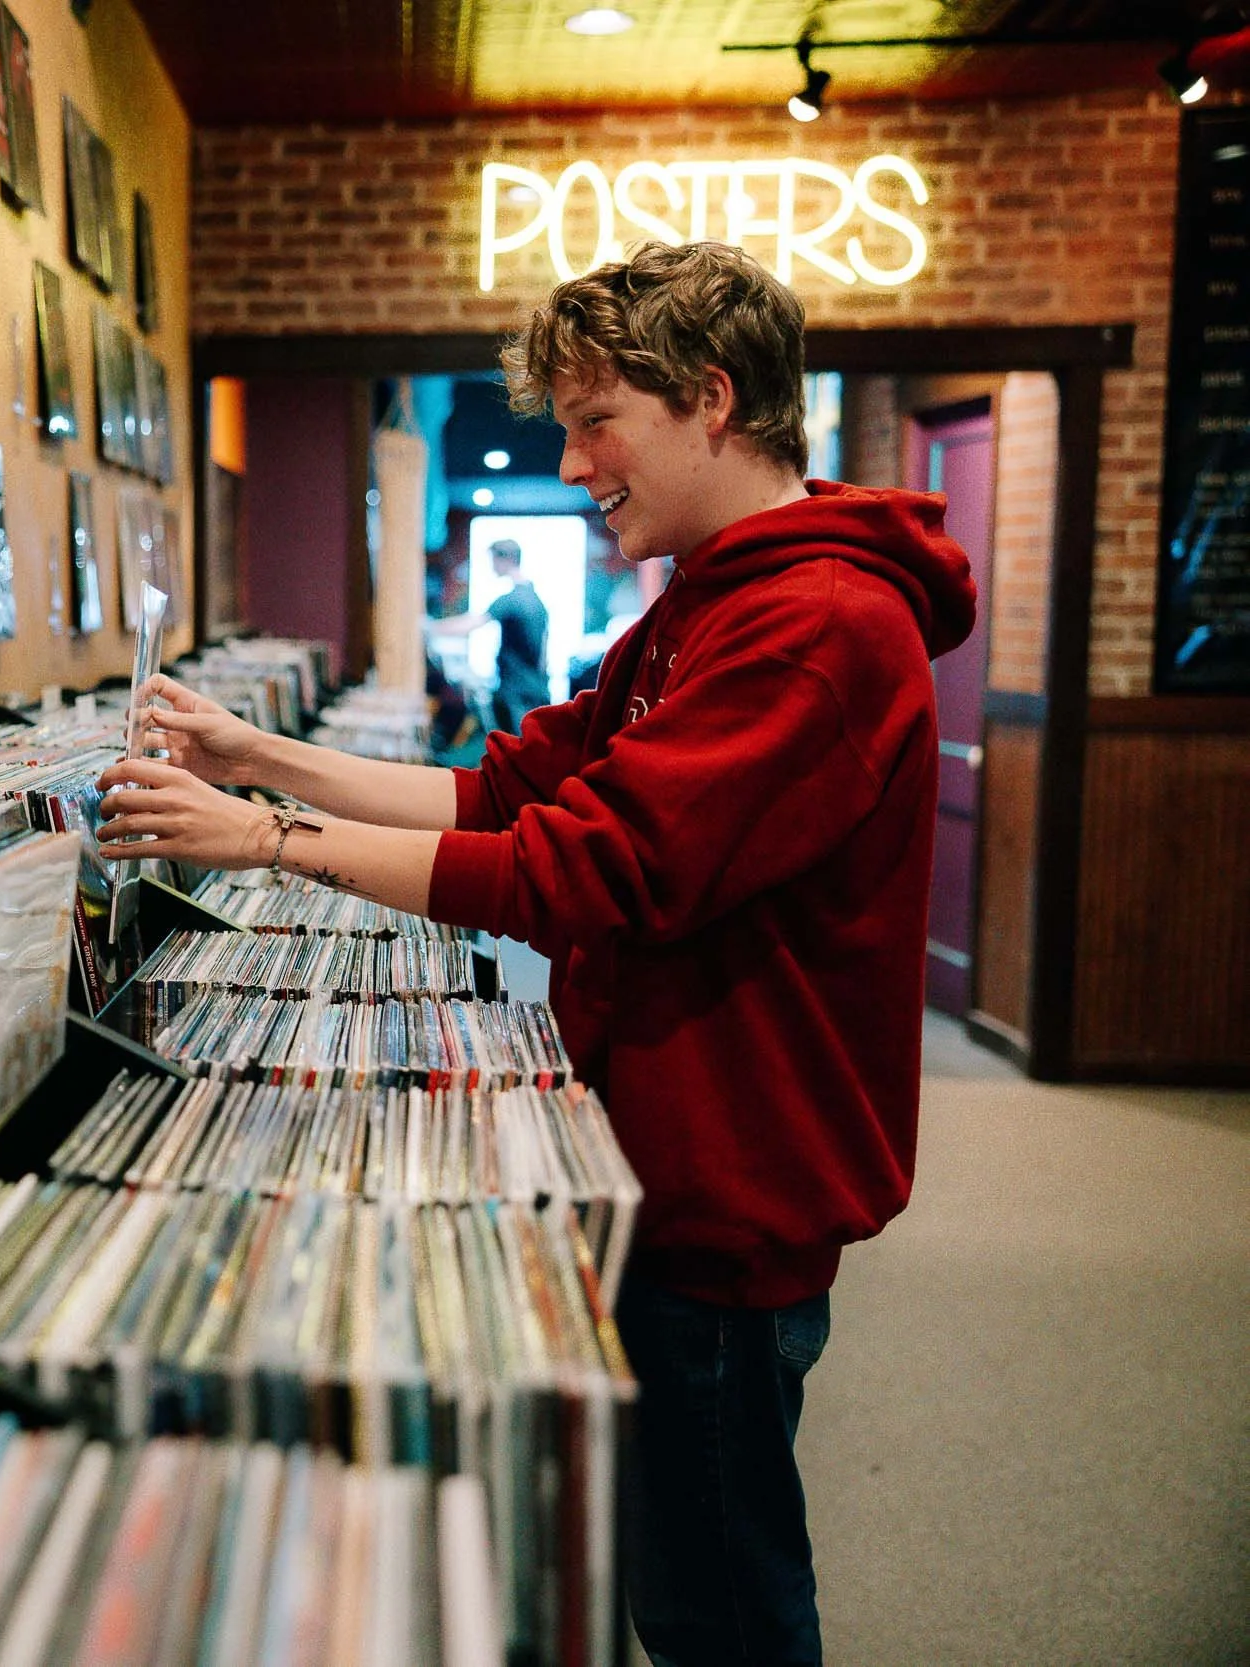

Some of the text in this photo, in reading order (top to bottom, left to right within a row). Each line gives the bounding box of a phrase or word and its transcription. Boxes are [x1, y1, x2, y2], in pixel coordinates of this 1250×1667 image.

[478, 154, 930, 292] POSTERS
[83, 945, 95, 972] GREEN
[90, 973, 98, 987] DAY
